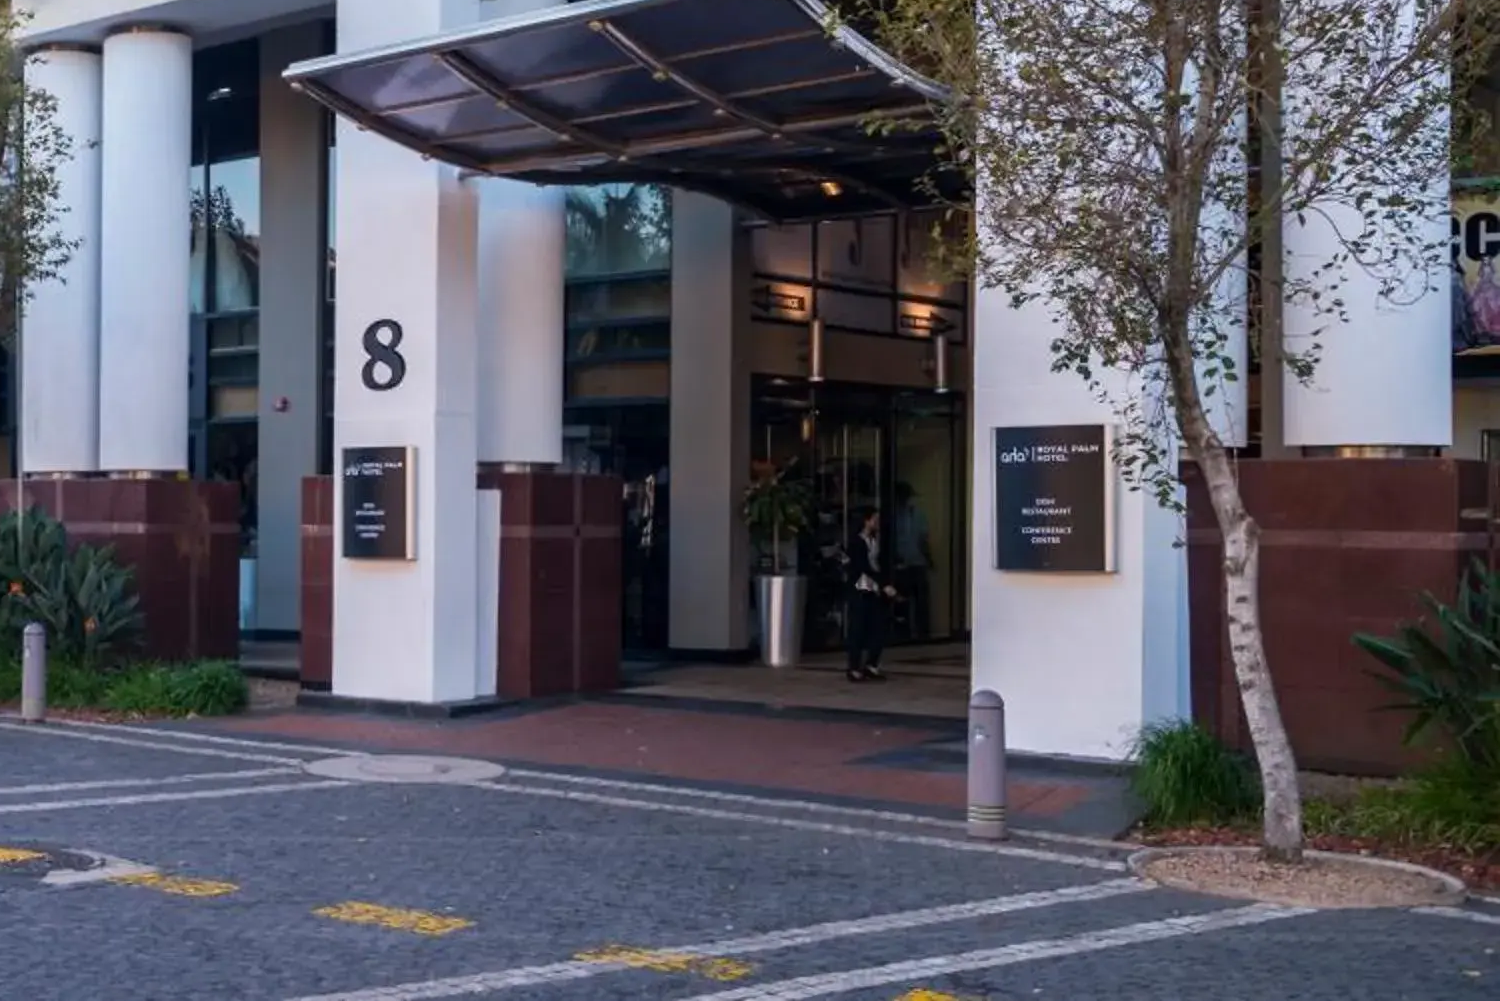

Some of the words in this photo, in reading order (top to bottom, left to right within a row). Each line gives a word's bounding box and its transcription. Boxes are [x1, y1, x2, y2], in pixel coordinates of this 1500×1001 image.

[362, 319, 406, 391] 8
[1037, 445, 1069, 454] ROYAL
[1071, 444, 1100, 453] PALM
[1037, 454, 1068, 462] HOTEL
[1021, 507, 1072, 516] RESTAURANT
[1021, 526, 1072, 535] CONFERENCE
